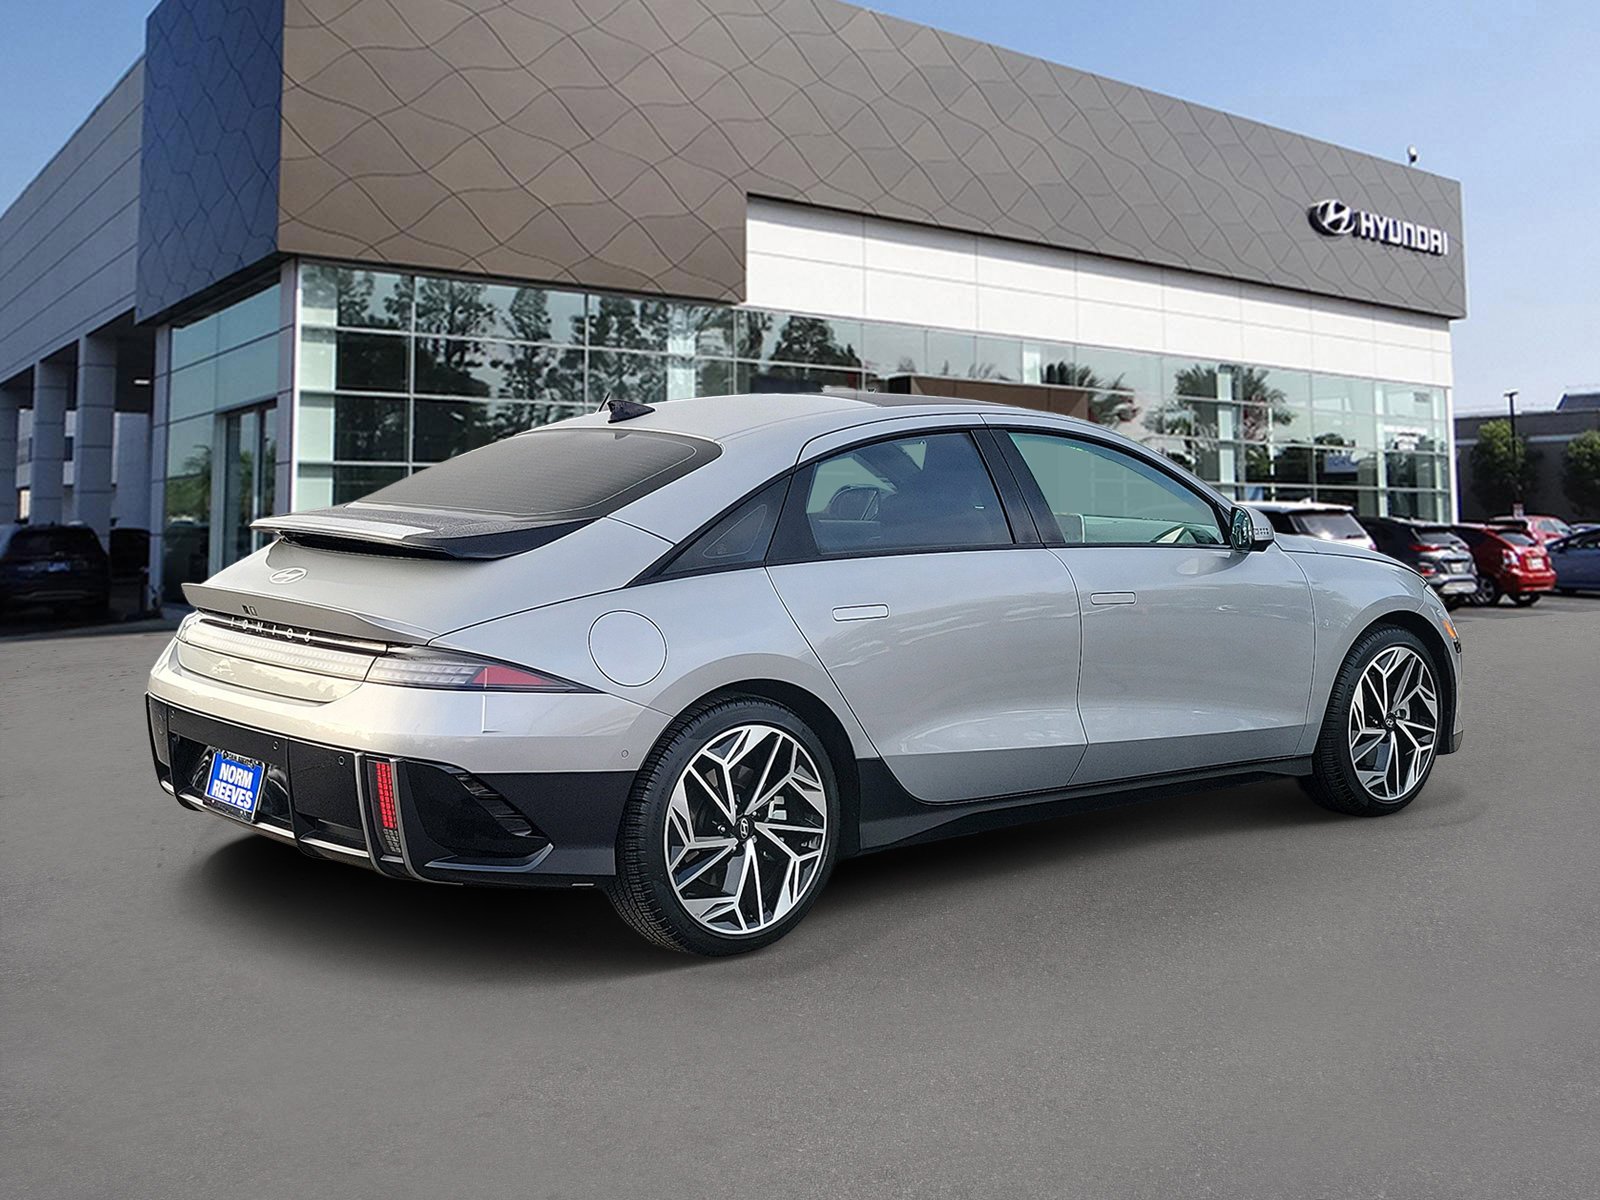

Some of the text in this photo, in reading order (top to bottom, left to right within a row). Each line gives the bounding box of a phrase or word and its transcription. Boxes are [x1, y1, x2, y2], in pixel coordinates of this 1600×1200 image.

[1360, 211, 1449, 255] HYUNDAI
[219, 762, 254, 790] NORM
[211, 779, 254, 809] REEVES
